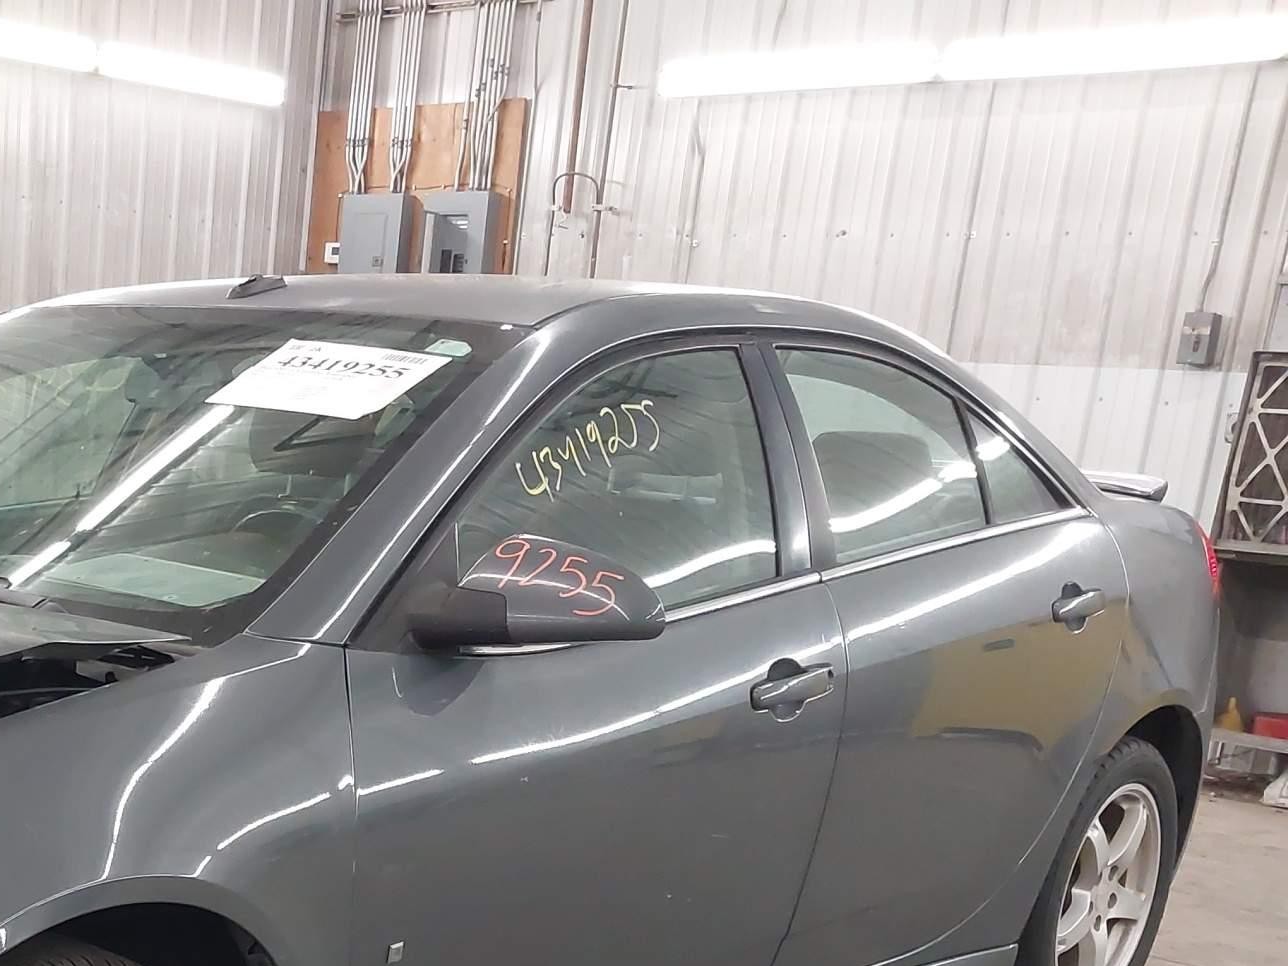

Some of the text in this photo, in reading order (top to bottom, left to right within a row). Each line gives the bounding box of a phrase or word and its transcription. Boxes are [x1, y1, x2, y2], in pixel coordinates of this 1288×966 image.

[278, 355, 411, 379] 43419255
[515, 400, 660, 502] 43419255
[495, 539, 625, 616] 9255
